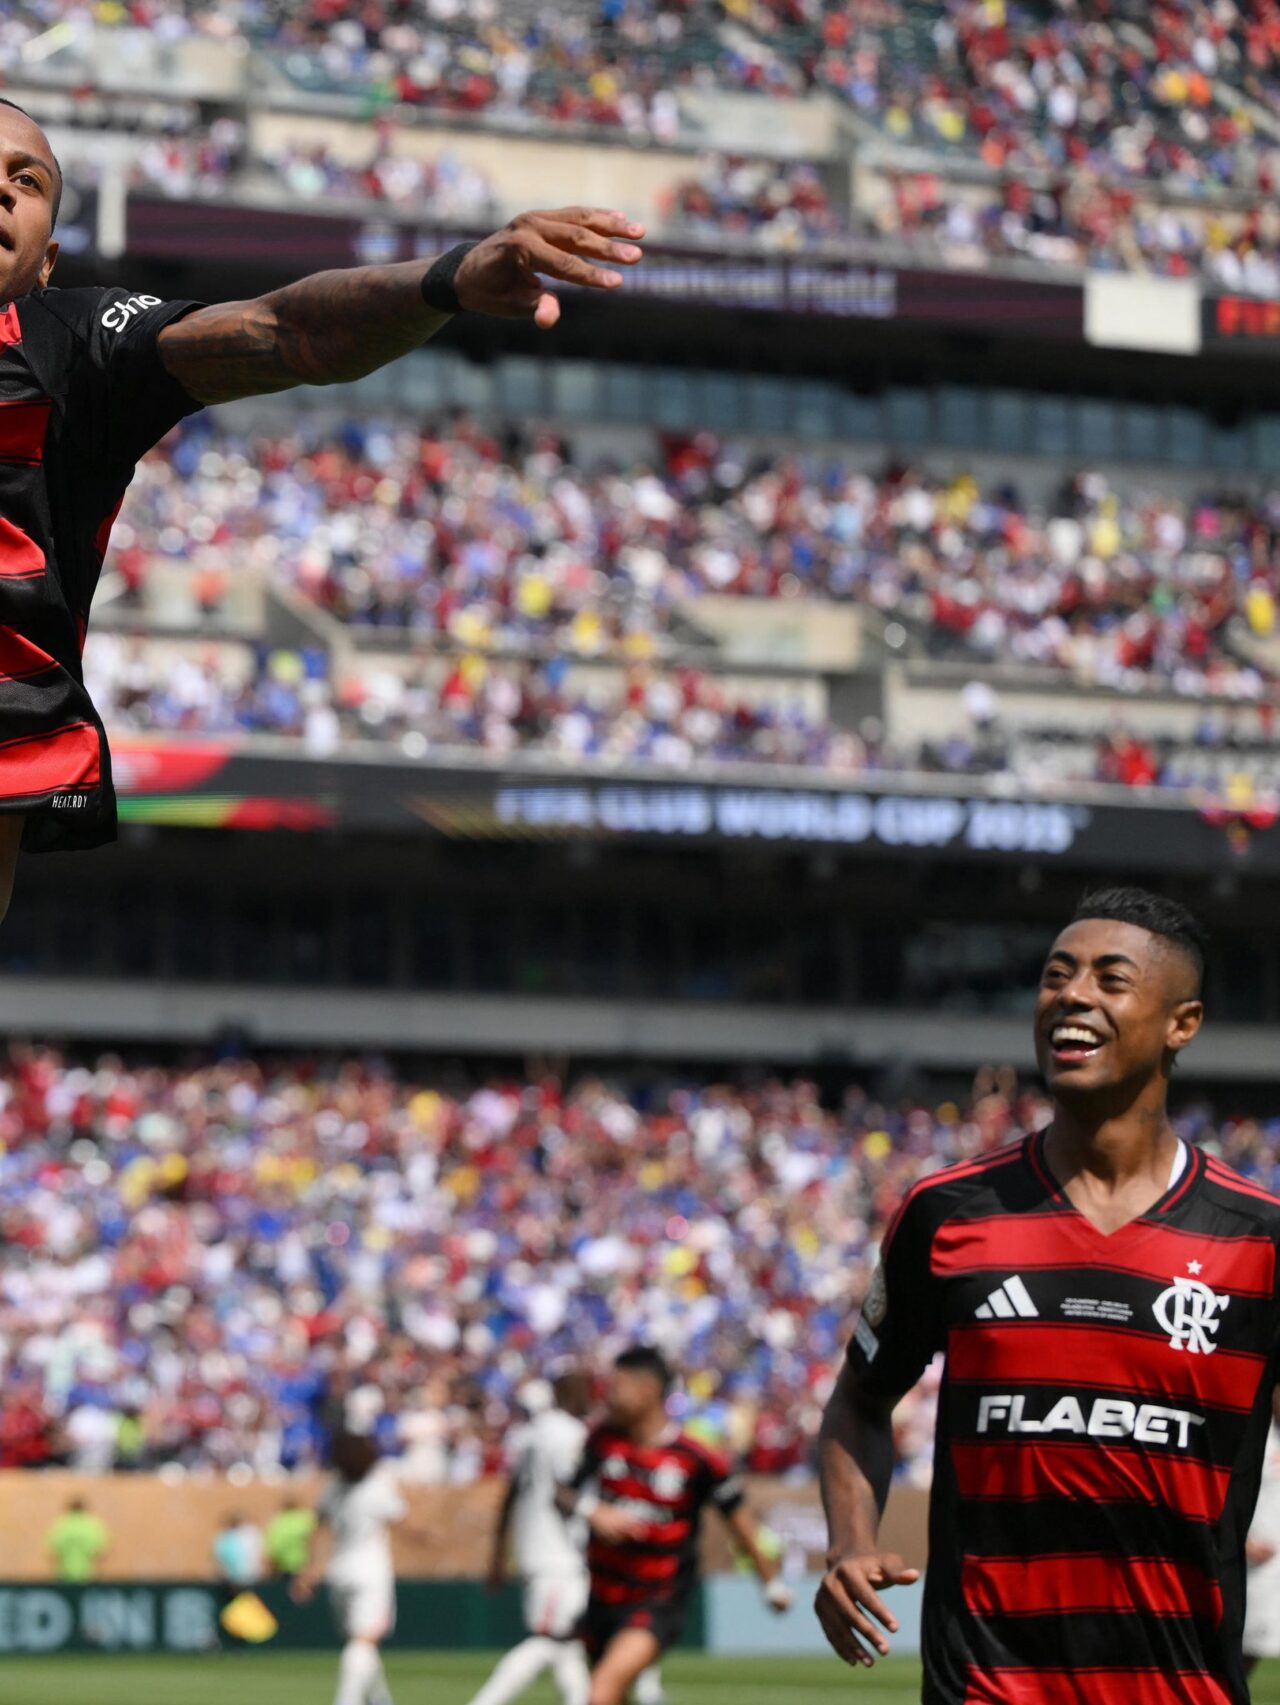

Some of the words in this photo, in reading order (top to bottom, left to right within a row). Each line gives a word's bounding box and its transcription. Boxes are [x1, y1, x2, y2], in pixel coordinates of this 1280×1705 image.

[52, 795, 87, 808] HEAT.RDY
[977, 1395, 1206, 1448] FLABET
[81, 1591, 155, 1650] IN
